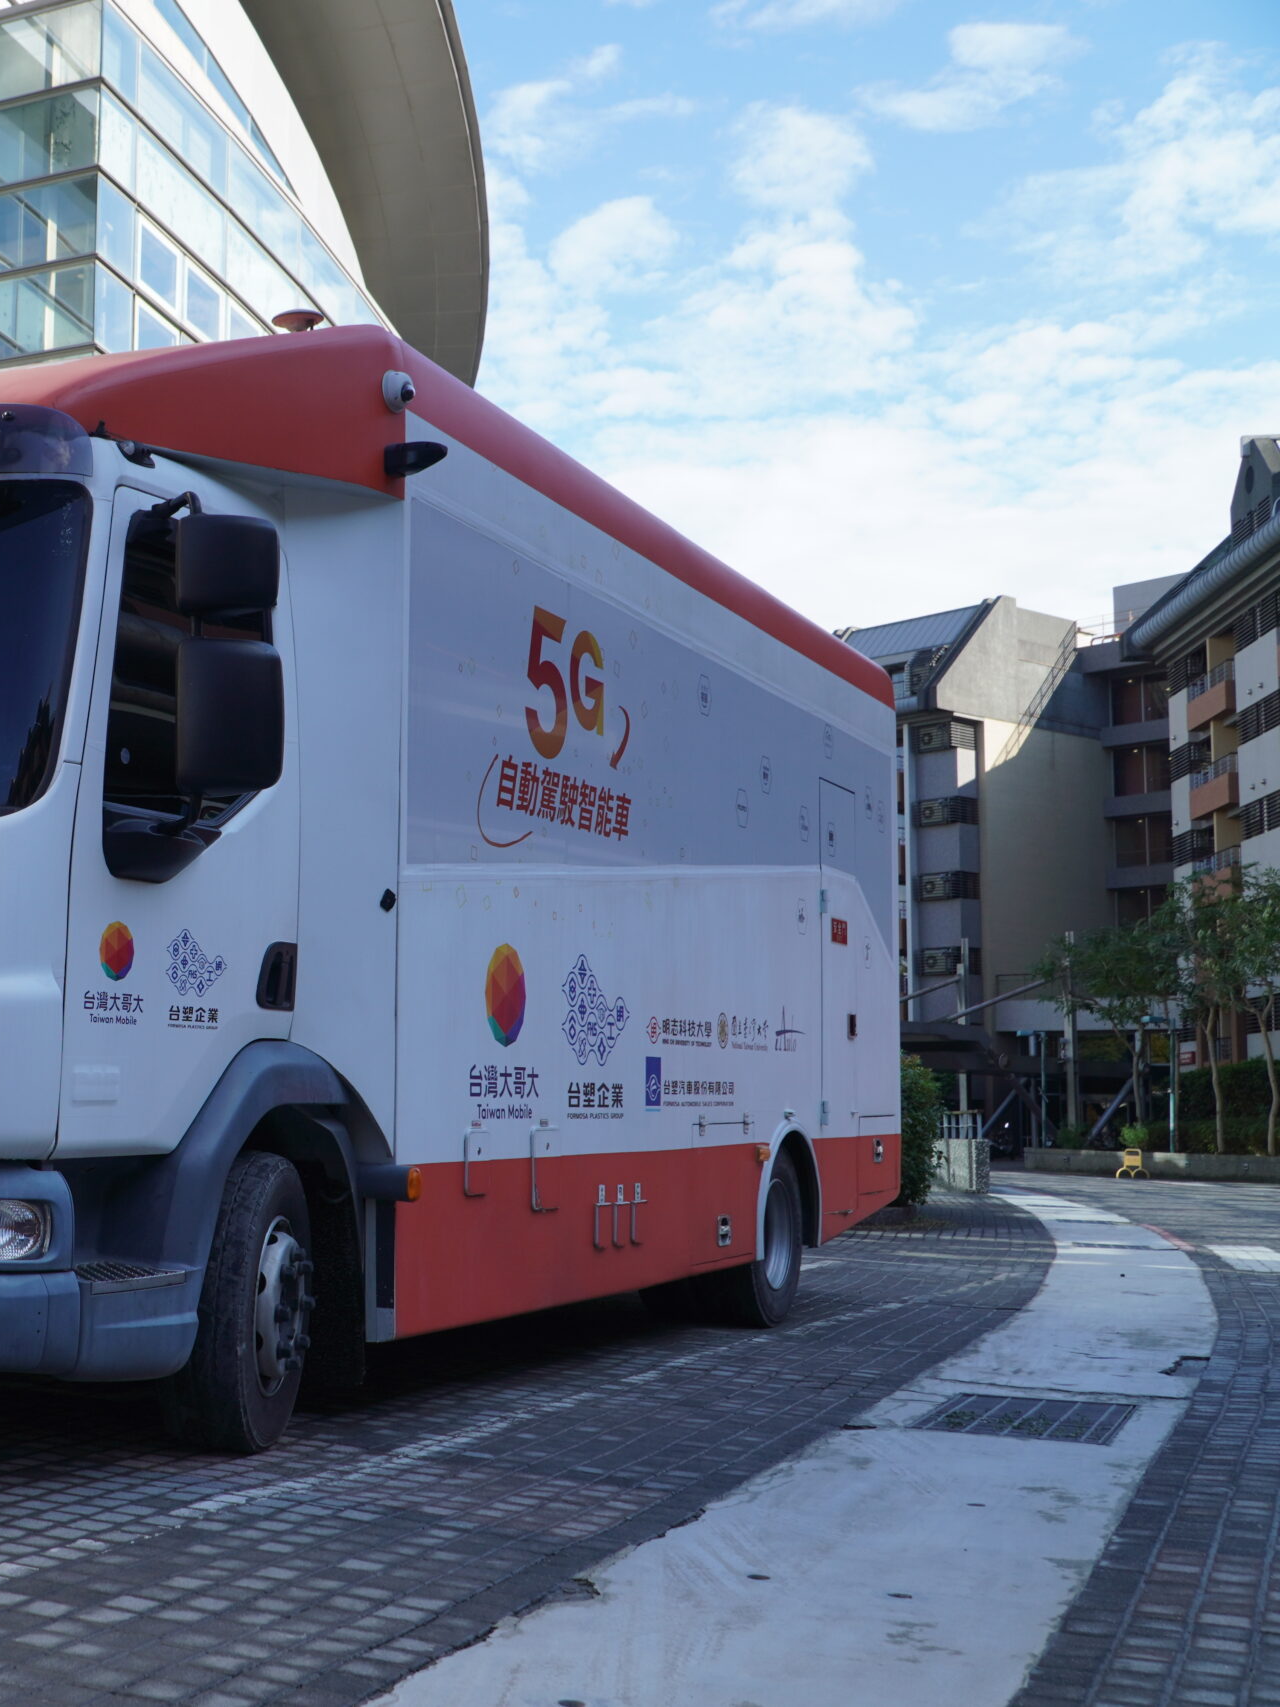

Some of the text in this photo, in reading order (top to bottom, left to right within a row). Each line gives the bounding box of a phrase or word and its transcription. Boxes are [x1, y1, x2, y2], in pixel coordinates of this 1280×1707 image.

[525, 605, 604, 760] 5G
[496, 754, 632, 842] 自動駕駛智能車
[83, 990, 144, 1013] 台灣大哥大
[90, 1013, 137, 1025] Taiwan Mobile
[168, 1005, 219, 1023] 台塑企業
[662, 1018, 712, 1039] 明志科技大學
[469, 1064, 539, 1099] 台灣大哥大
[663, 1080, 735, 1096] 台塑汽車股份有限公司
[567, 1082, 624, 1109] 台塑企業
[477, 1103, 532, 1119] Taiwan Mobile
